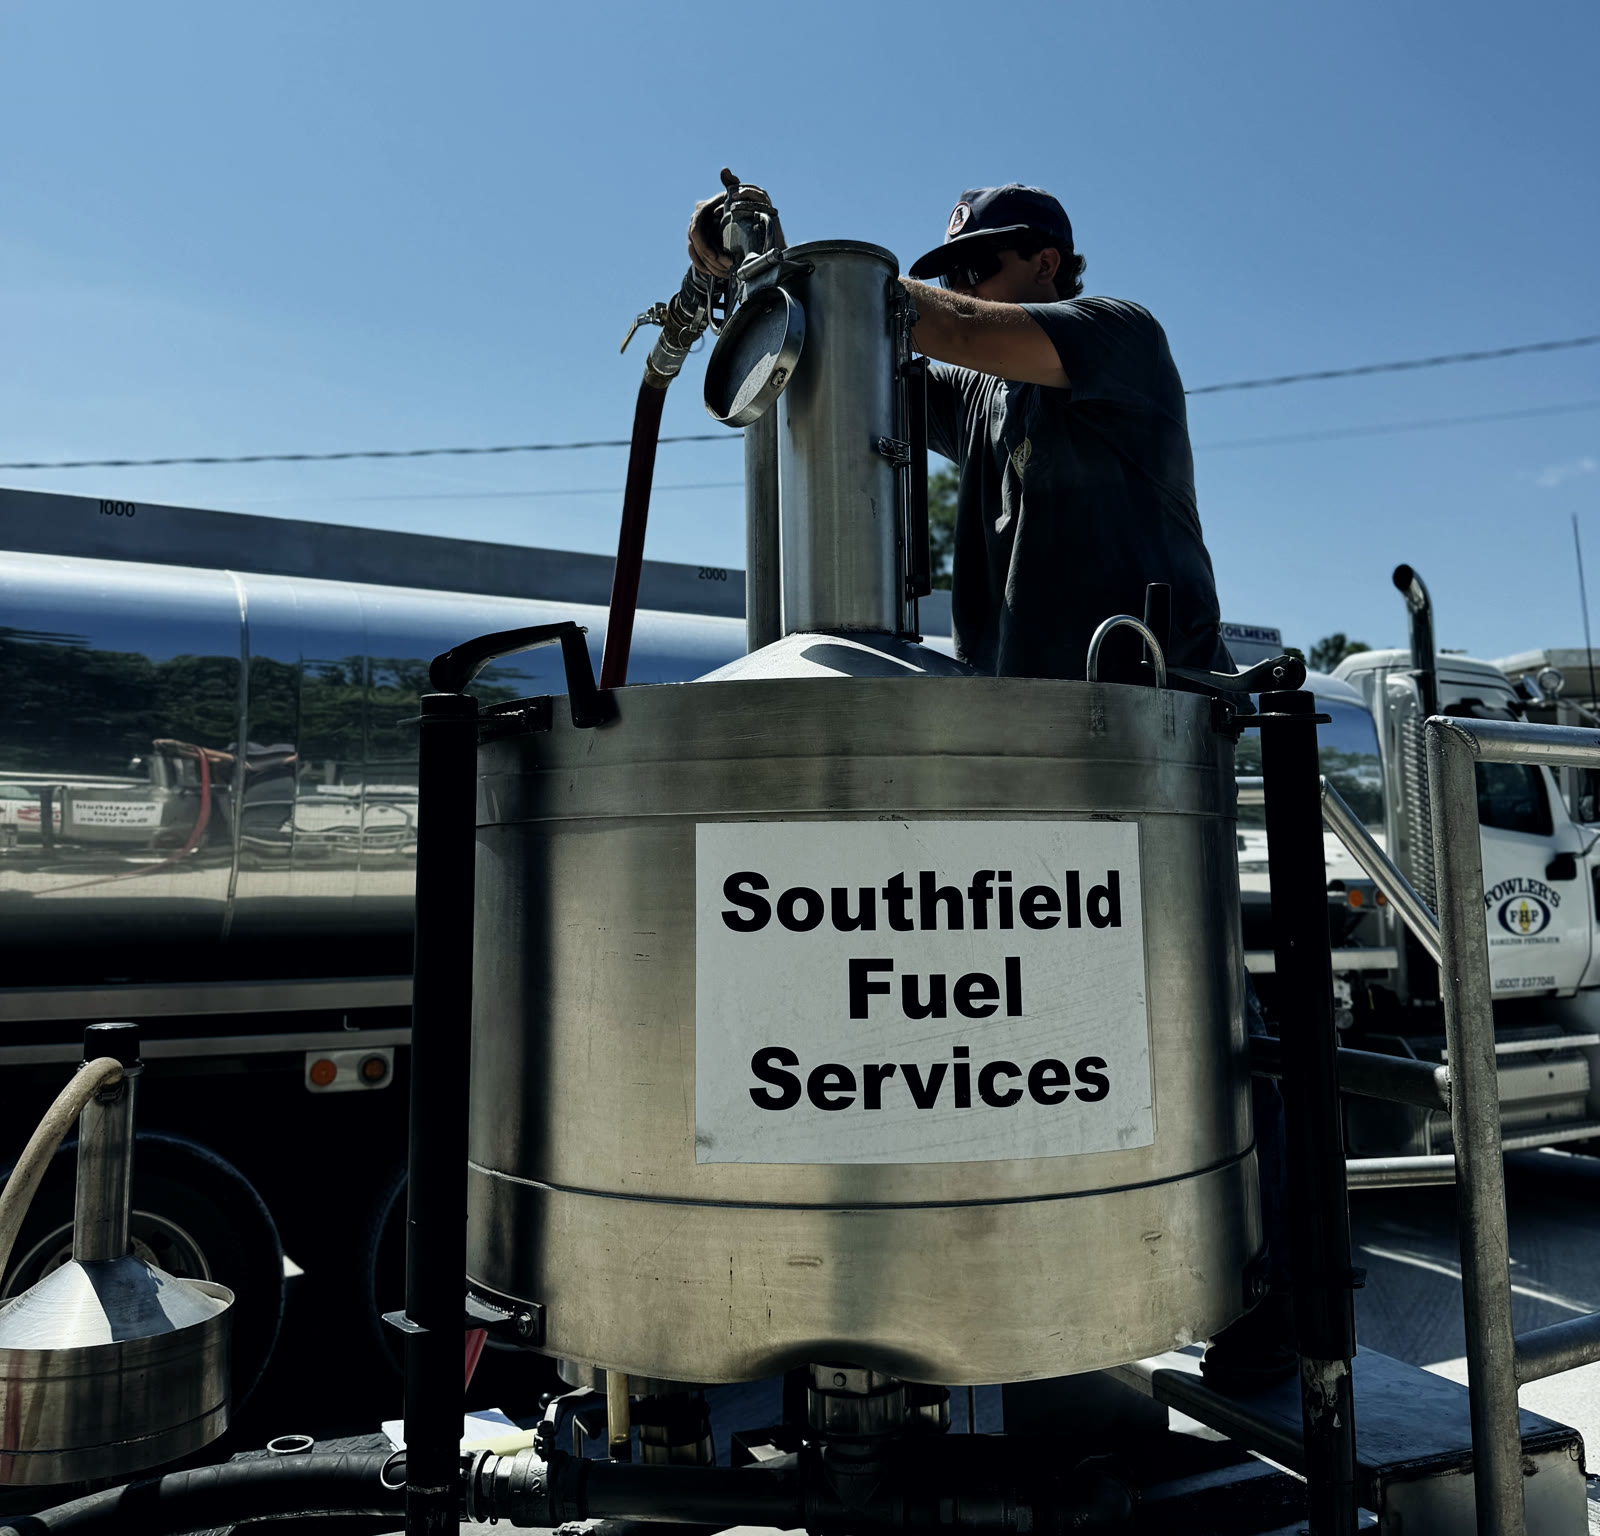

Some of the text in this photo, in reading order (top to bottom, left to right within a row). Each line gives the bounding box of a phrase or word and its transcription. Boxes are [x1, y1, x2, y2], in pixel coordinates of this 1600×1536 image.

[99, 500, 136, 517] 1000
[698, 566, 727, 581] 2000
[1224, 626, 1278, 642] OILMENS
[721, 870, 1122, 932] Southfield
[1484, 877, 1561, 911] FOWLER'S
[848, 956, 1023, 1019] Fuel
[749, 1046, 1111, 1111] Services
